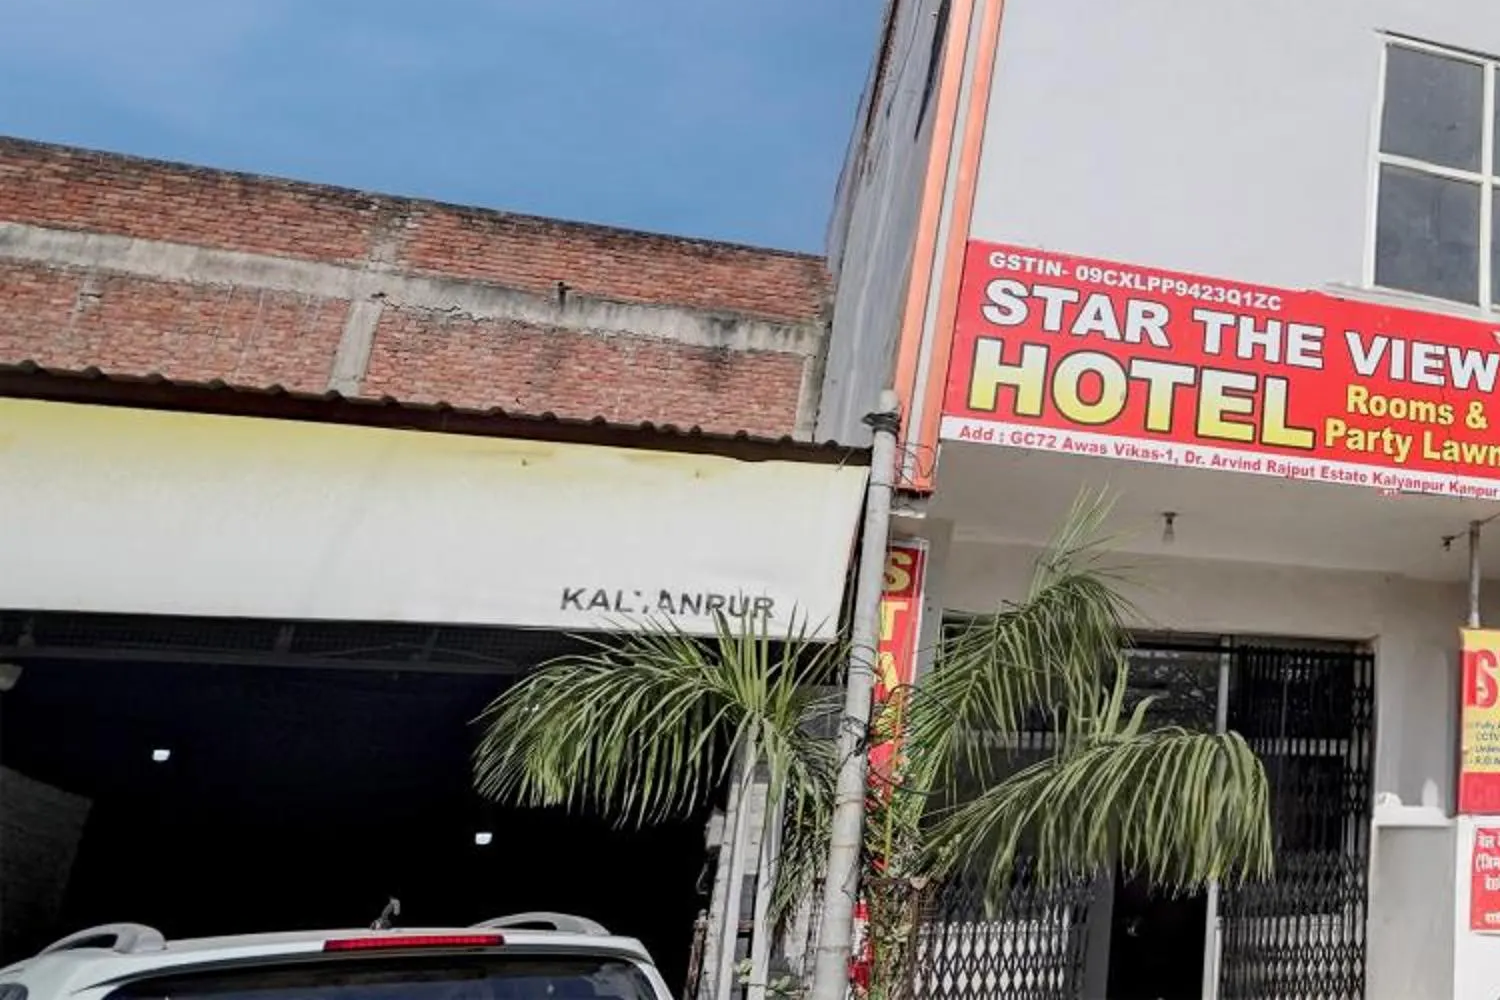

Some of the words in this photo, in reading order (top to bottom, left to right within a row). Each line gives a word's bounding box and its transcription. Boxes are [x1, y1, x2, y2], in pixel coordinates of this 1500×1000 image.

[988, 252, 1070, 277] GSTIN-
[982, 277, 1171, 347] STAR
[1194, 309, 1324, 369] THE
[1344, 330, 1500, 393] VIEW
[967, 337, 1315, 450] HOTEL
[1346, 384, 1454, 427] Rooms
[1464, 401, 1488, 428] &
[1325, 418, 1412, 462] Party
[1010, 430, 1057, 449] GC72
[1062, 437, 1107, 455] Awas
[1114, 443, 1179, 464] Vikas-1,
[1184, 450, 1205, 465] Dr.
[1211, 452, 1260, 471] Arvind
[1267, 460, 1315, 479] Rajput
[1320, 466, 1367, 484] Estate
[1372, 470, 1444, 492] Kalyanpur
[1450, 482, 1498, 499] Kanpur
[560, 586, 775, 619] KALANPUR
